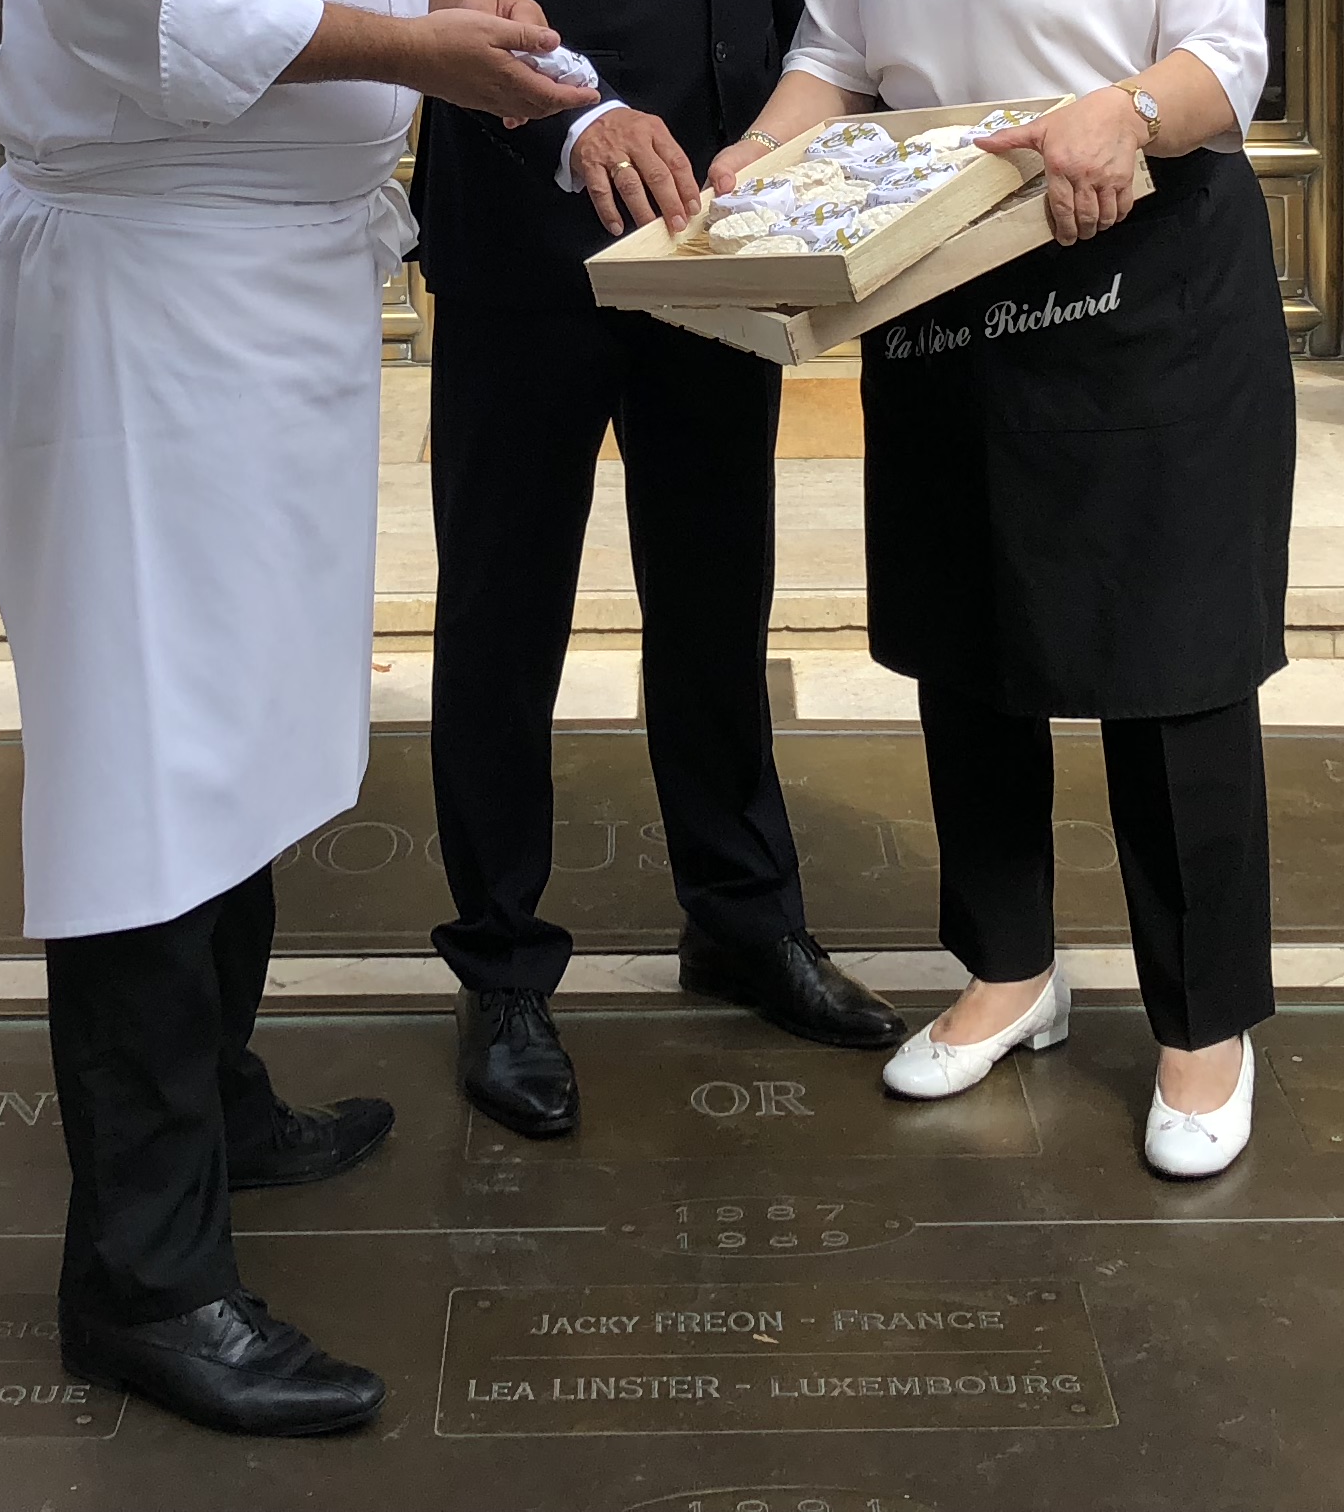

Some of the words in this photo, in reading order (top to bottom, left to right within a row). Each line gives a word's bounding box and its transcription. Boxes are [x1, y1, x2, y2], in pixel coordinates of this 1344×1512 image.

[984, 272, 1123, 339] Richard
[690, 1081, 815, 1118] OR
[675, 1204, 844, 1223] 1987
[530, 1313, 641, 1335] JACKY
[655, 1310, 783, 1333] FREON
[833, 1310, 1004, 1331] FRANCE
[467, 1379, 535, 1401] LEA
[552, 1375, 721, 1400] LINSTER
[770, 1374, 1082, 1398] LUXEMBOURG
